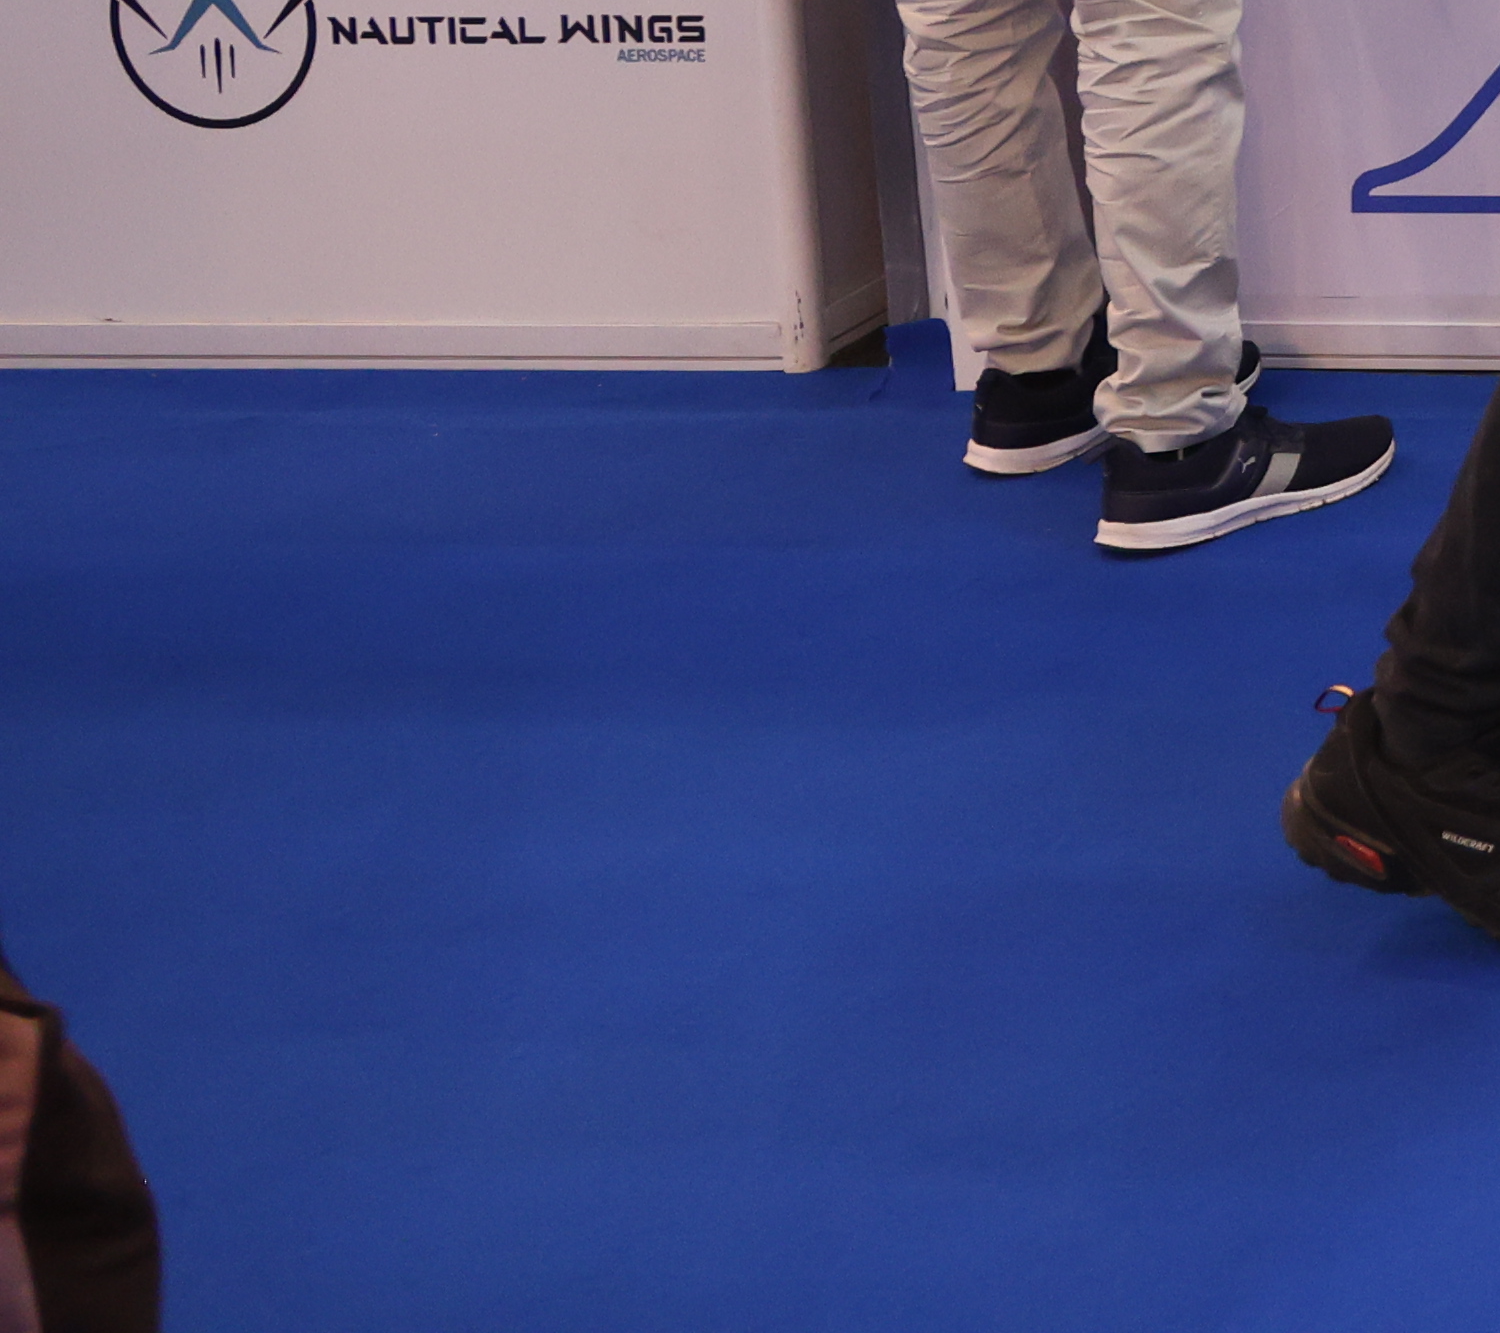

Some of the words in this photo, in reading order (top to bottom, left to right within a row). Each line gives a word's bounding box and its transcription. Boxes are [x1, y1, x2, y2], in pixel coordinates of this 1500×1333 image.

[327, 15, 547, 46] NAUTICAL
[558, 14, 706, 44] WINGS
[617, 48, 706, 63] AEROSPACE
